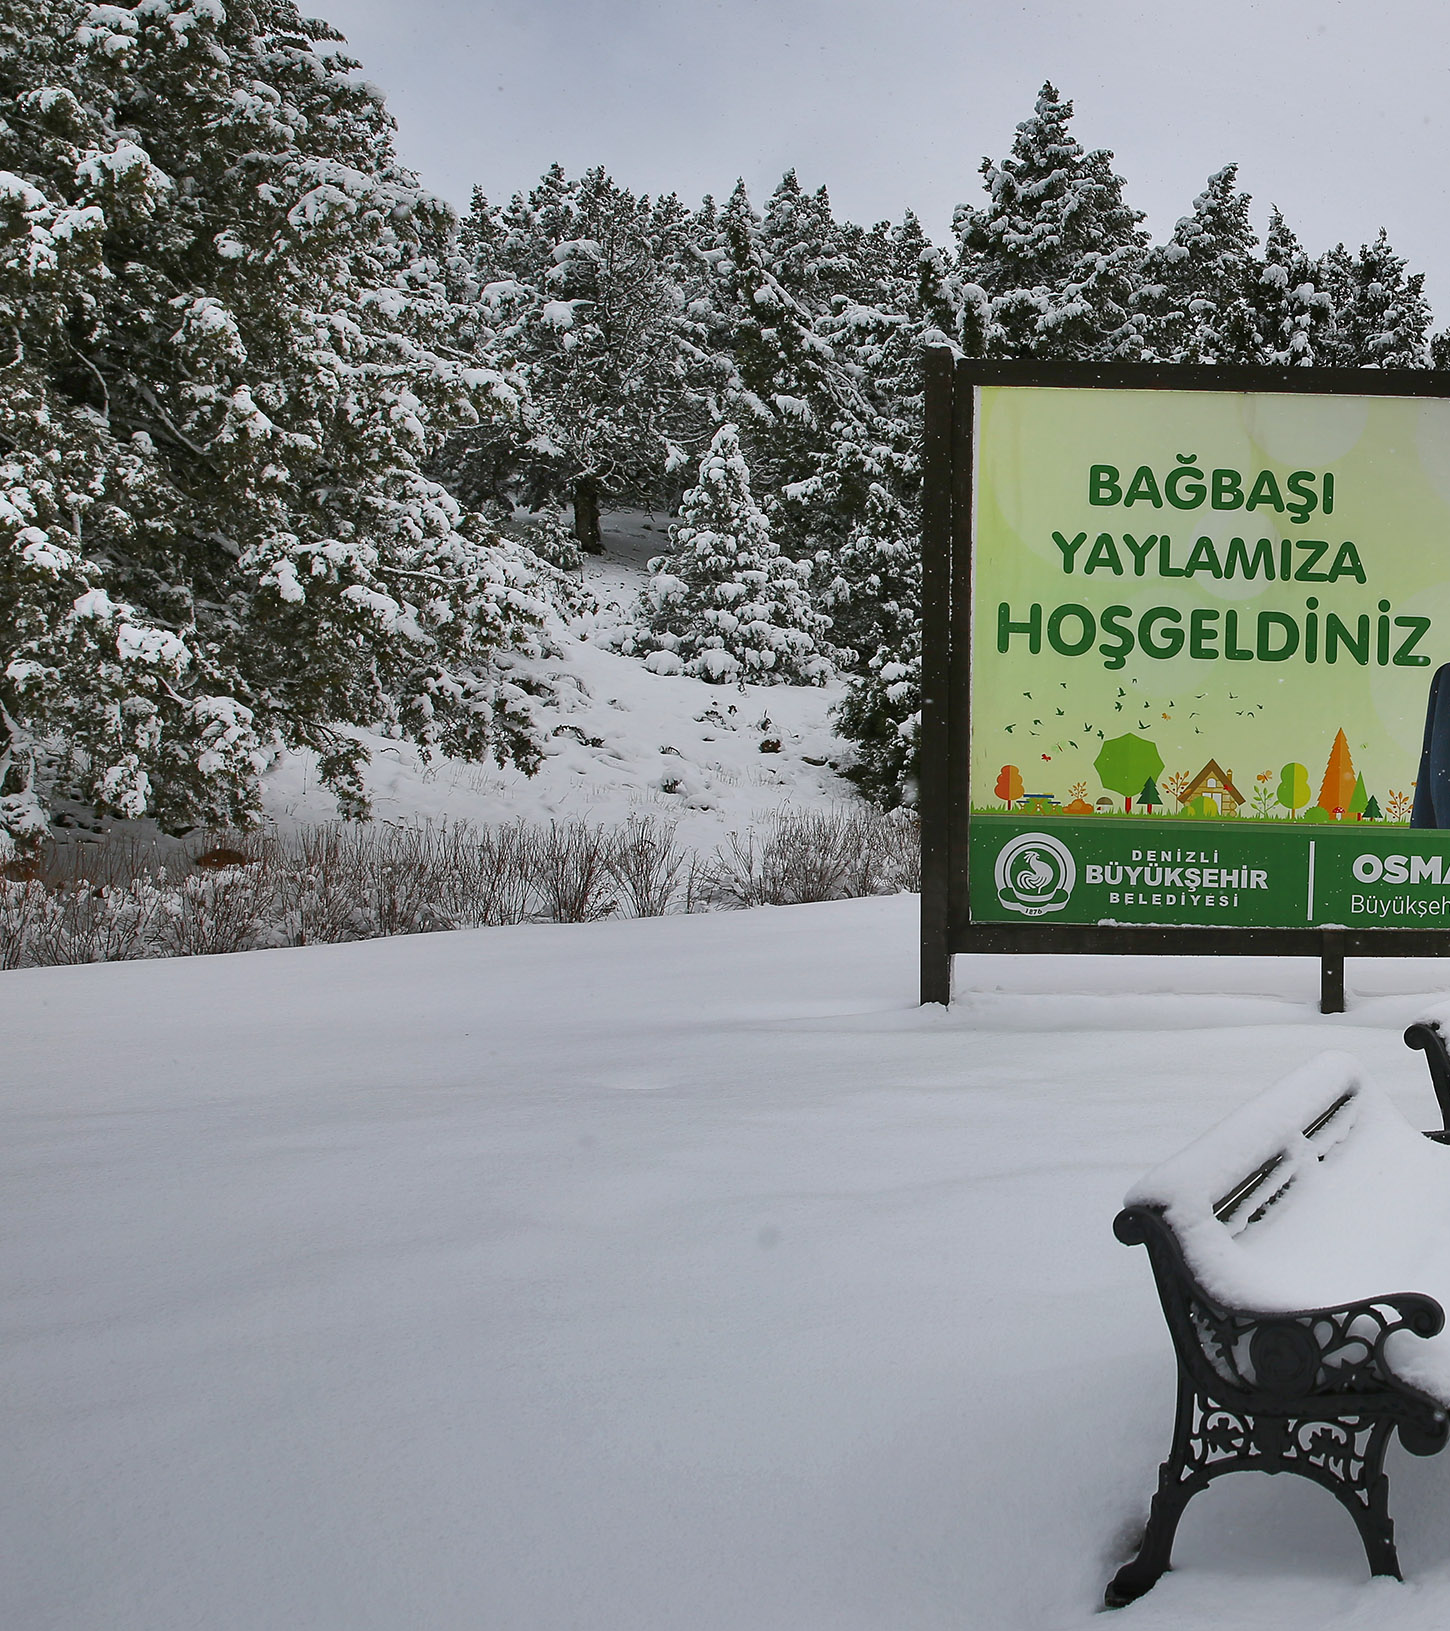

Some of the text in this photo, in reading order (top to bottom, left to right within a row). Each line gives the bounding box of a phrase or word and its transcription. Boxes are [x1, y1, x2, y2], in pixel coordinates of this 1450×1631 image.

[1089, 453, 1334, 524] BAĞBAŞI
[1051, 531, 1367, 585] YAYLAMIZA
[997, 597, 1432, 670] HOŞGELDİNİZ
[1085, 861, 1269, 892] BÜYÜKŞEHİR
[1131, 848, 1219, 863] DENİZLİ
[1109, 892, 1239, 907] BELEDİYESİ
